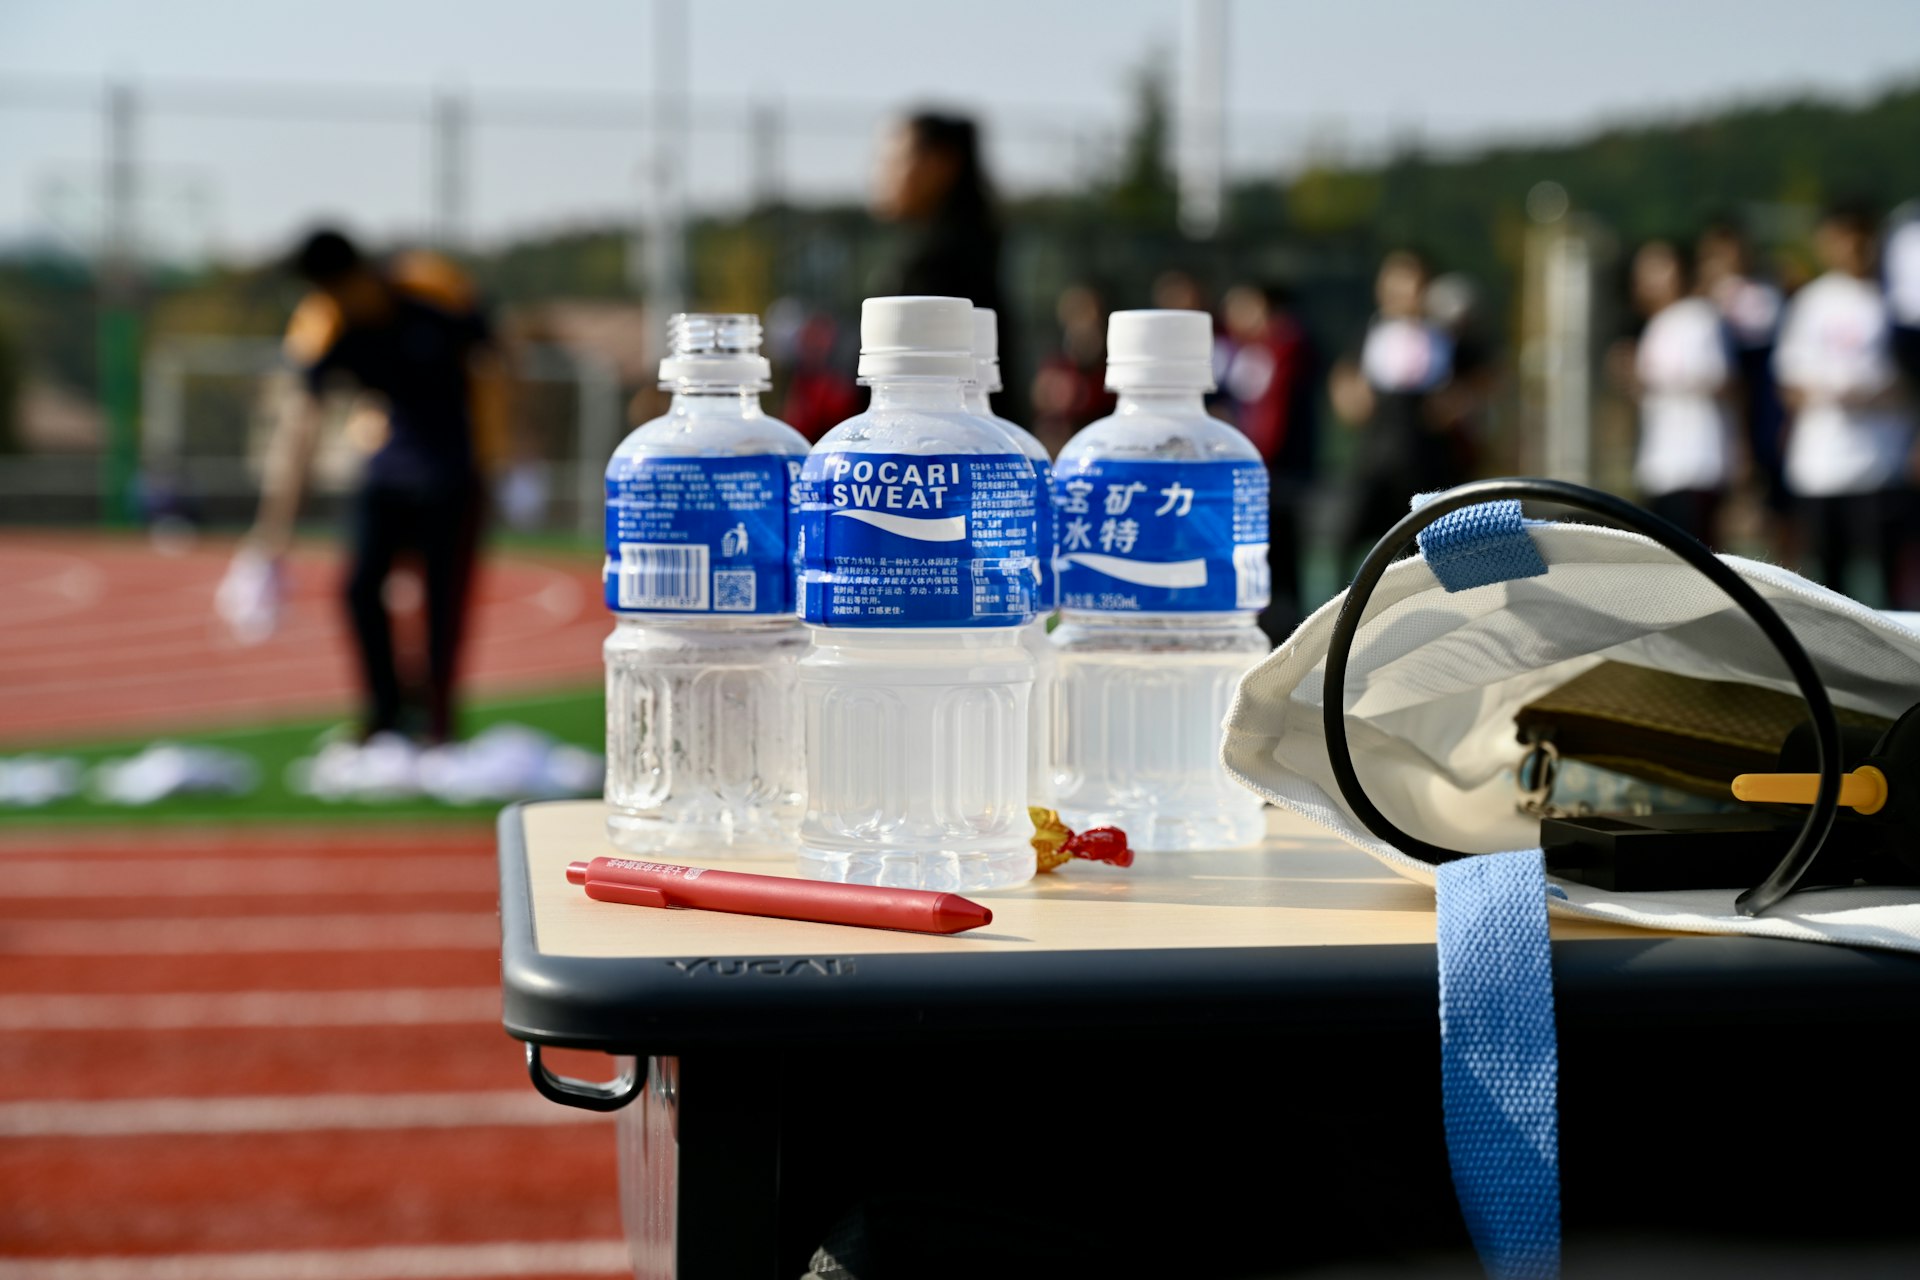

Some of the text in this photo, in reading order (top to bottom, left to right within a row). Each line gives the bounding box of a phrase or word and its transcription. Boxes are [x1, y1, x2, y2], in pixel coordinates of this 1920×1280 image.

[833, 460, 960, 487] POCARI
[833, 484, 948, 509] SWEAT
[1063, 478, 1195, 517] 宝矿力
[1062, 516, 1140, 554] 水特
